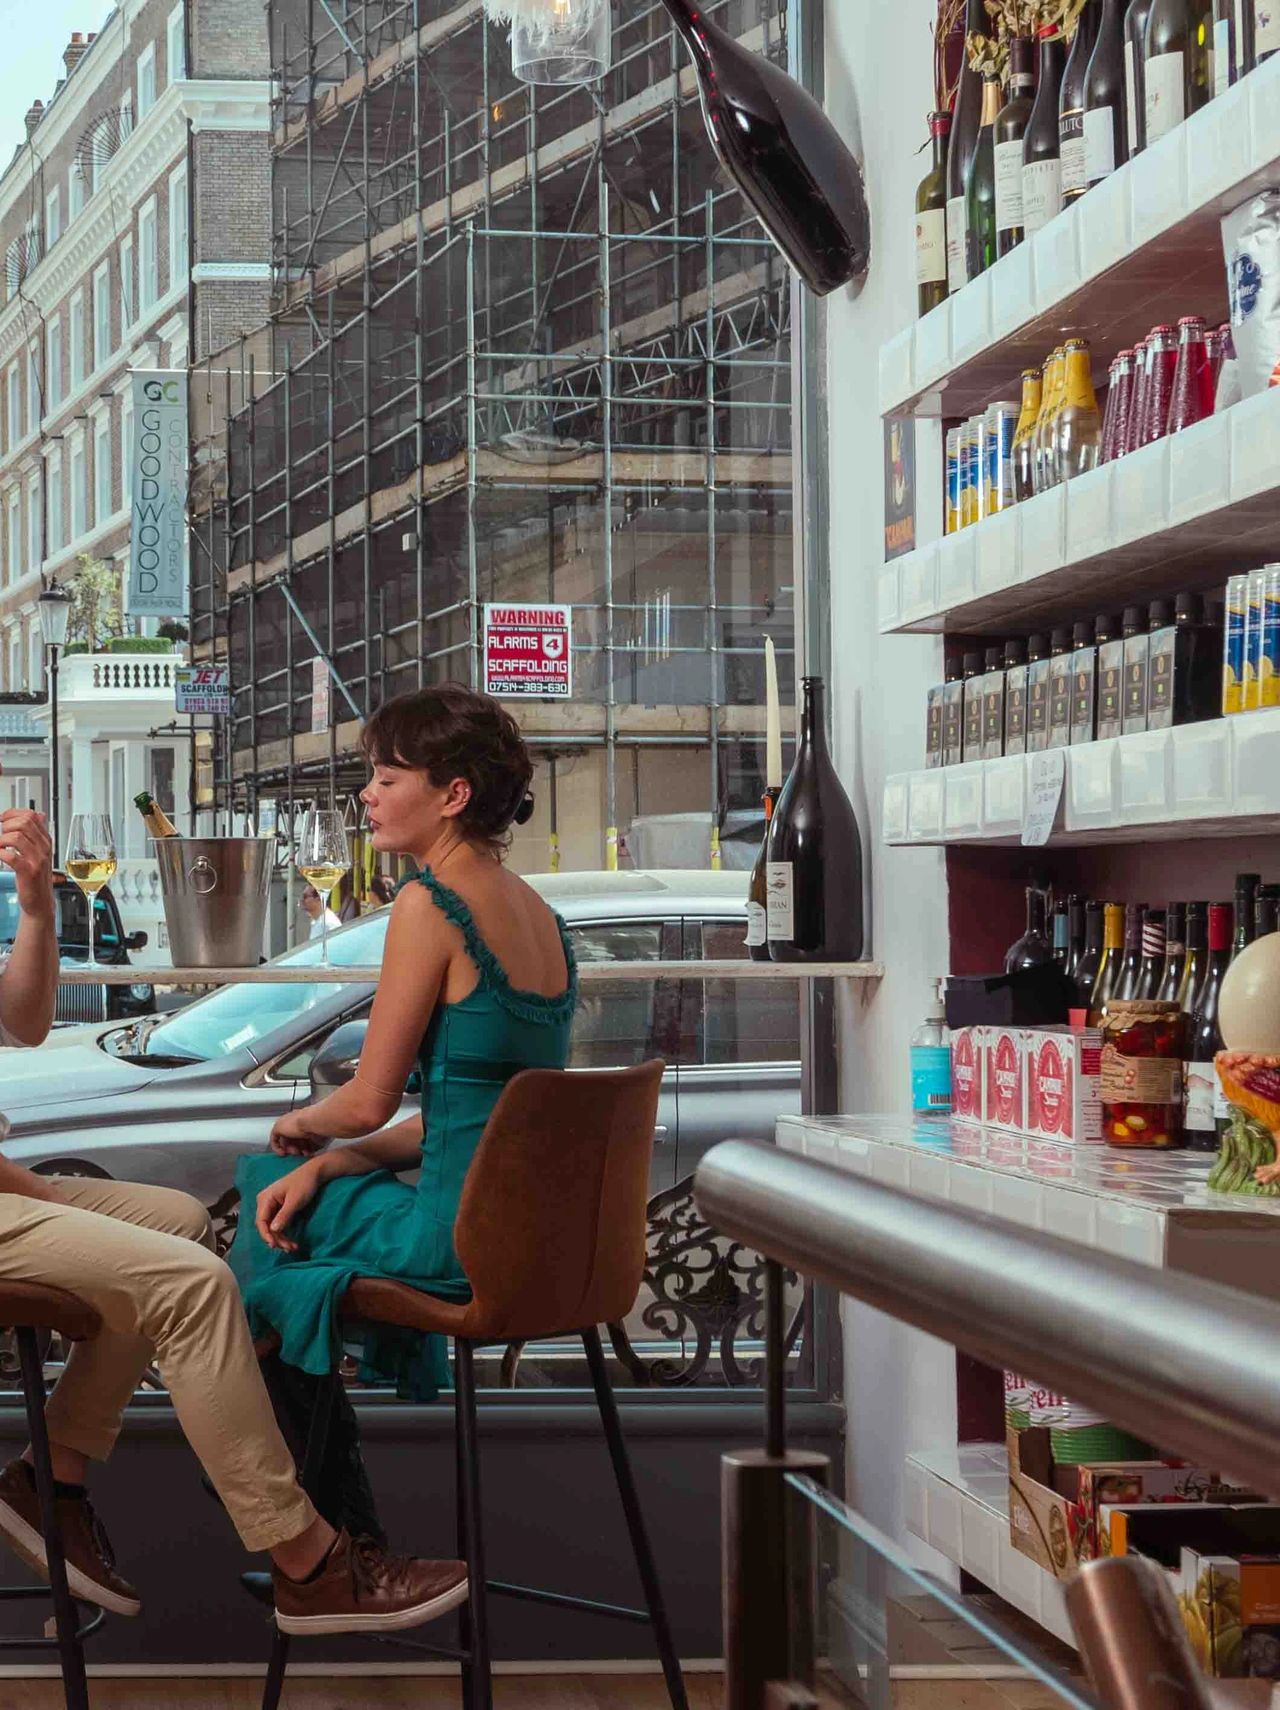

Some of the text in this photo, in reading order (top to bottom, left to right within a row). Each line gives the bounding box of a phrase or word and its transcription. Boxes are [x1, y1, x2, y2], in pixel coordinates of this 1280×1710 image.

[144, 381, 179, 402] GC
[136, 409, 165, 593] GOODWOOD
[167, 419, 183, 583] CONTRACTORS
[490, 609, 565, 625] WARNING
[488, 636, 560, 650] ALARMS 4
[488, 659, 568, 673] SCAFFOLDING
[193, 670, 225, 684] JET
[489, 682, 567, 692] 07514-383-630
